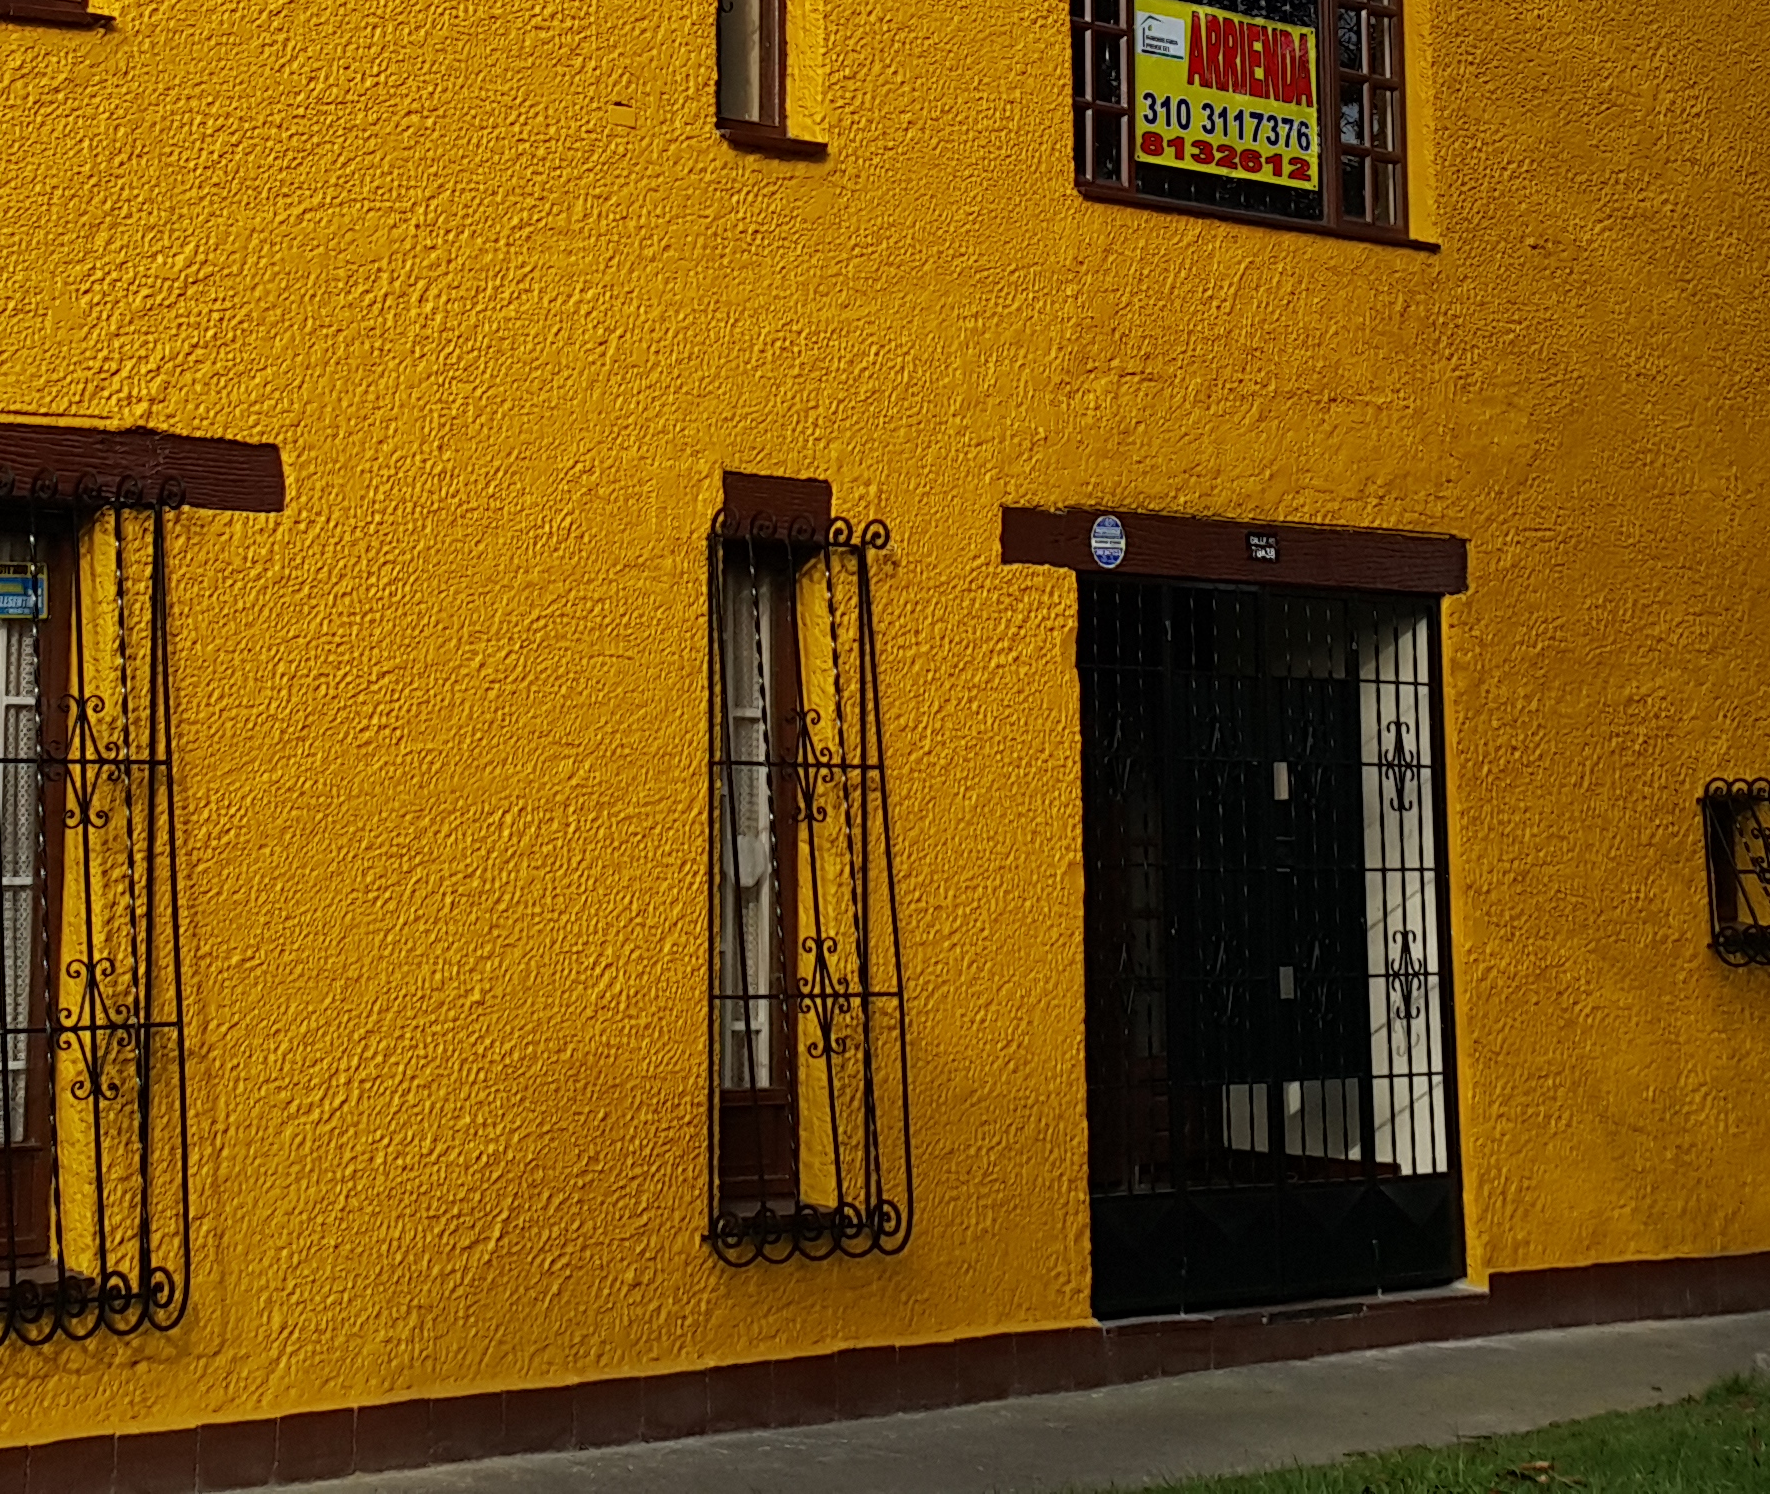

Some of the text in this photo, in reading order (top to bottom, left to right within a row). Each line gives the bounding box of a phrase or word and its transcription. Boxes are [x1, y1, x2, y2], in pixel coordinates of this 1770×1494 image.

[1187, 11, 1313, 108] ARRIENDA
[1142, 92, 1312, 153] 310 3117376
[1140, 131, 1312, 181] 8132612
